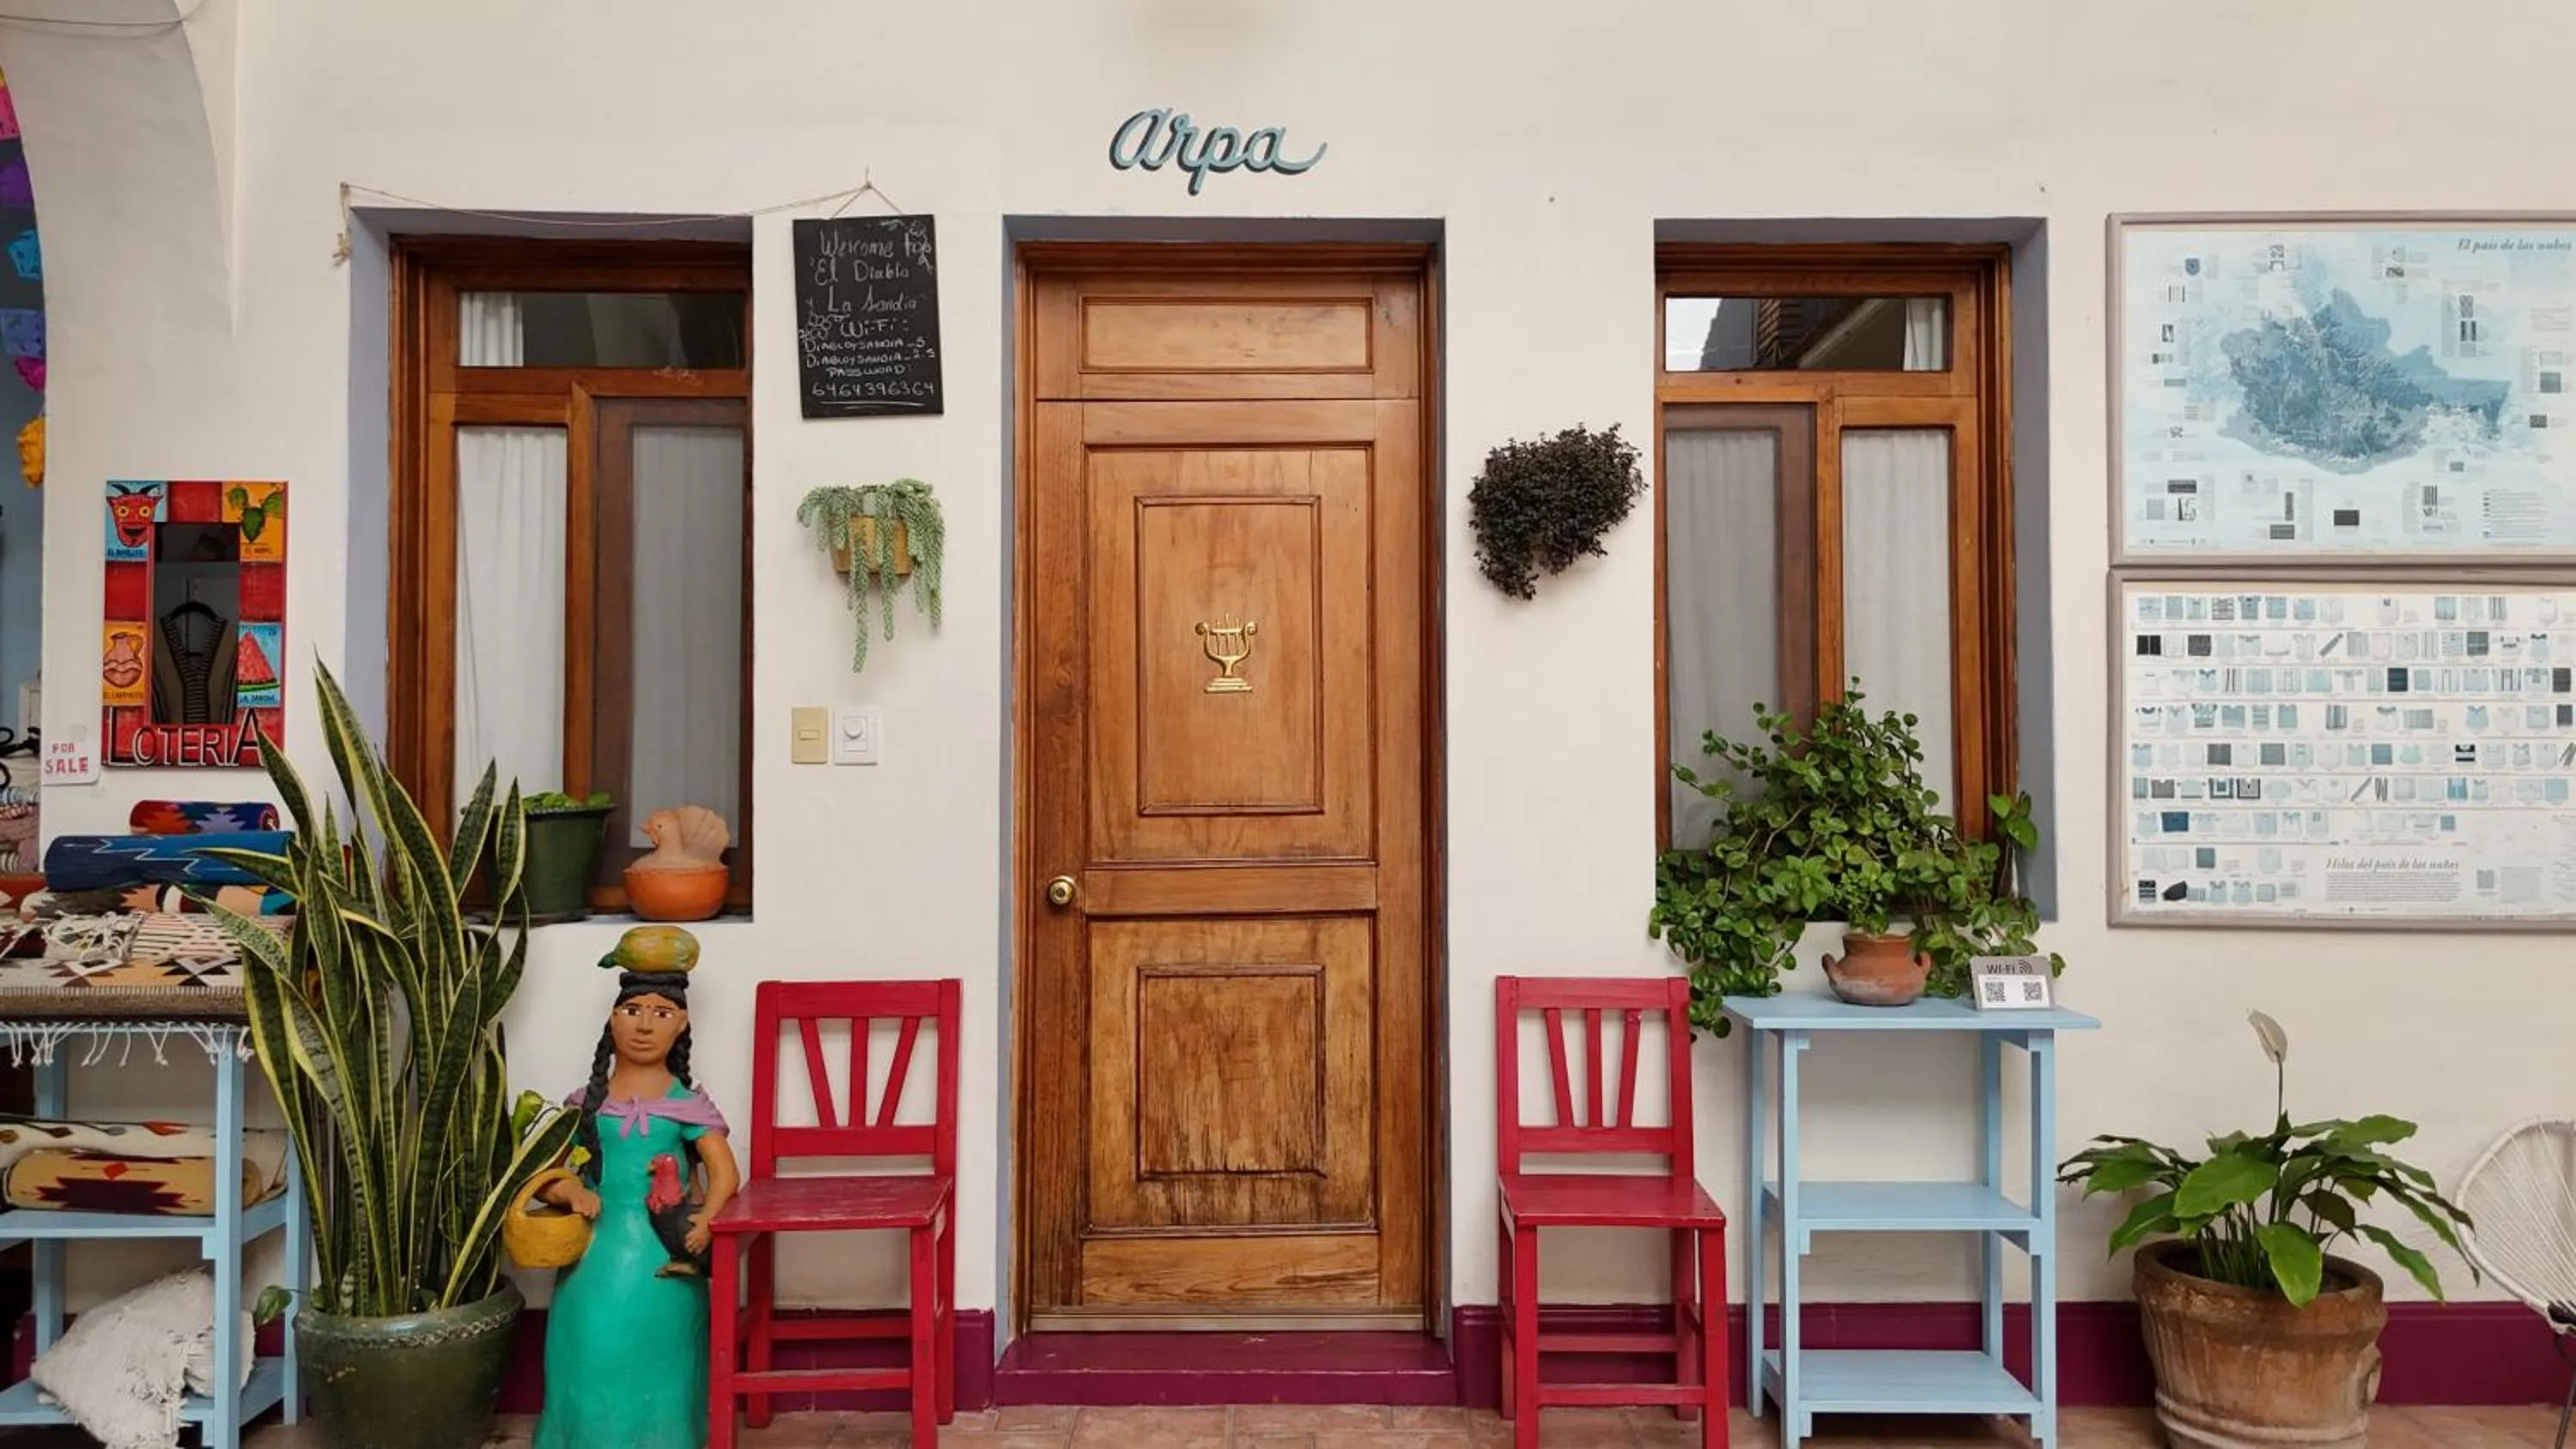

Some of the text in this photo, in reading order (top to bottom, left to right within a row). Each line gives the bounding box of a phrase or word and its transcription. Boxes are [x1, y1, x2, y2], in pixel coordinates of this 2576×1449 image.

[820, 228, 894, 258] Welcome
[2500, 238, 2515, 250] de
[815, 257, 910, 286] El Diablo
[828, 285, 852, 312] La
[52, 743, 75, 754] FOR
[108, 706, 266, 767] LOTERIA
[46, 756, 88, 774] SALE
